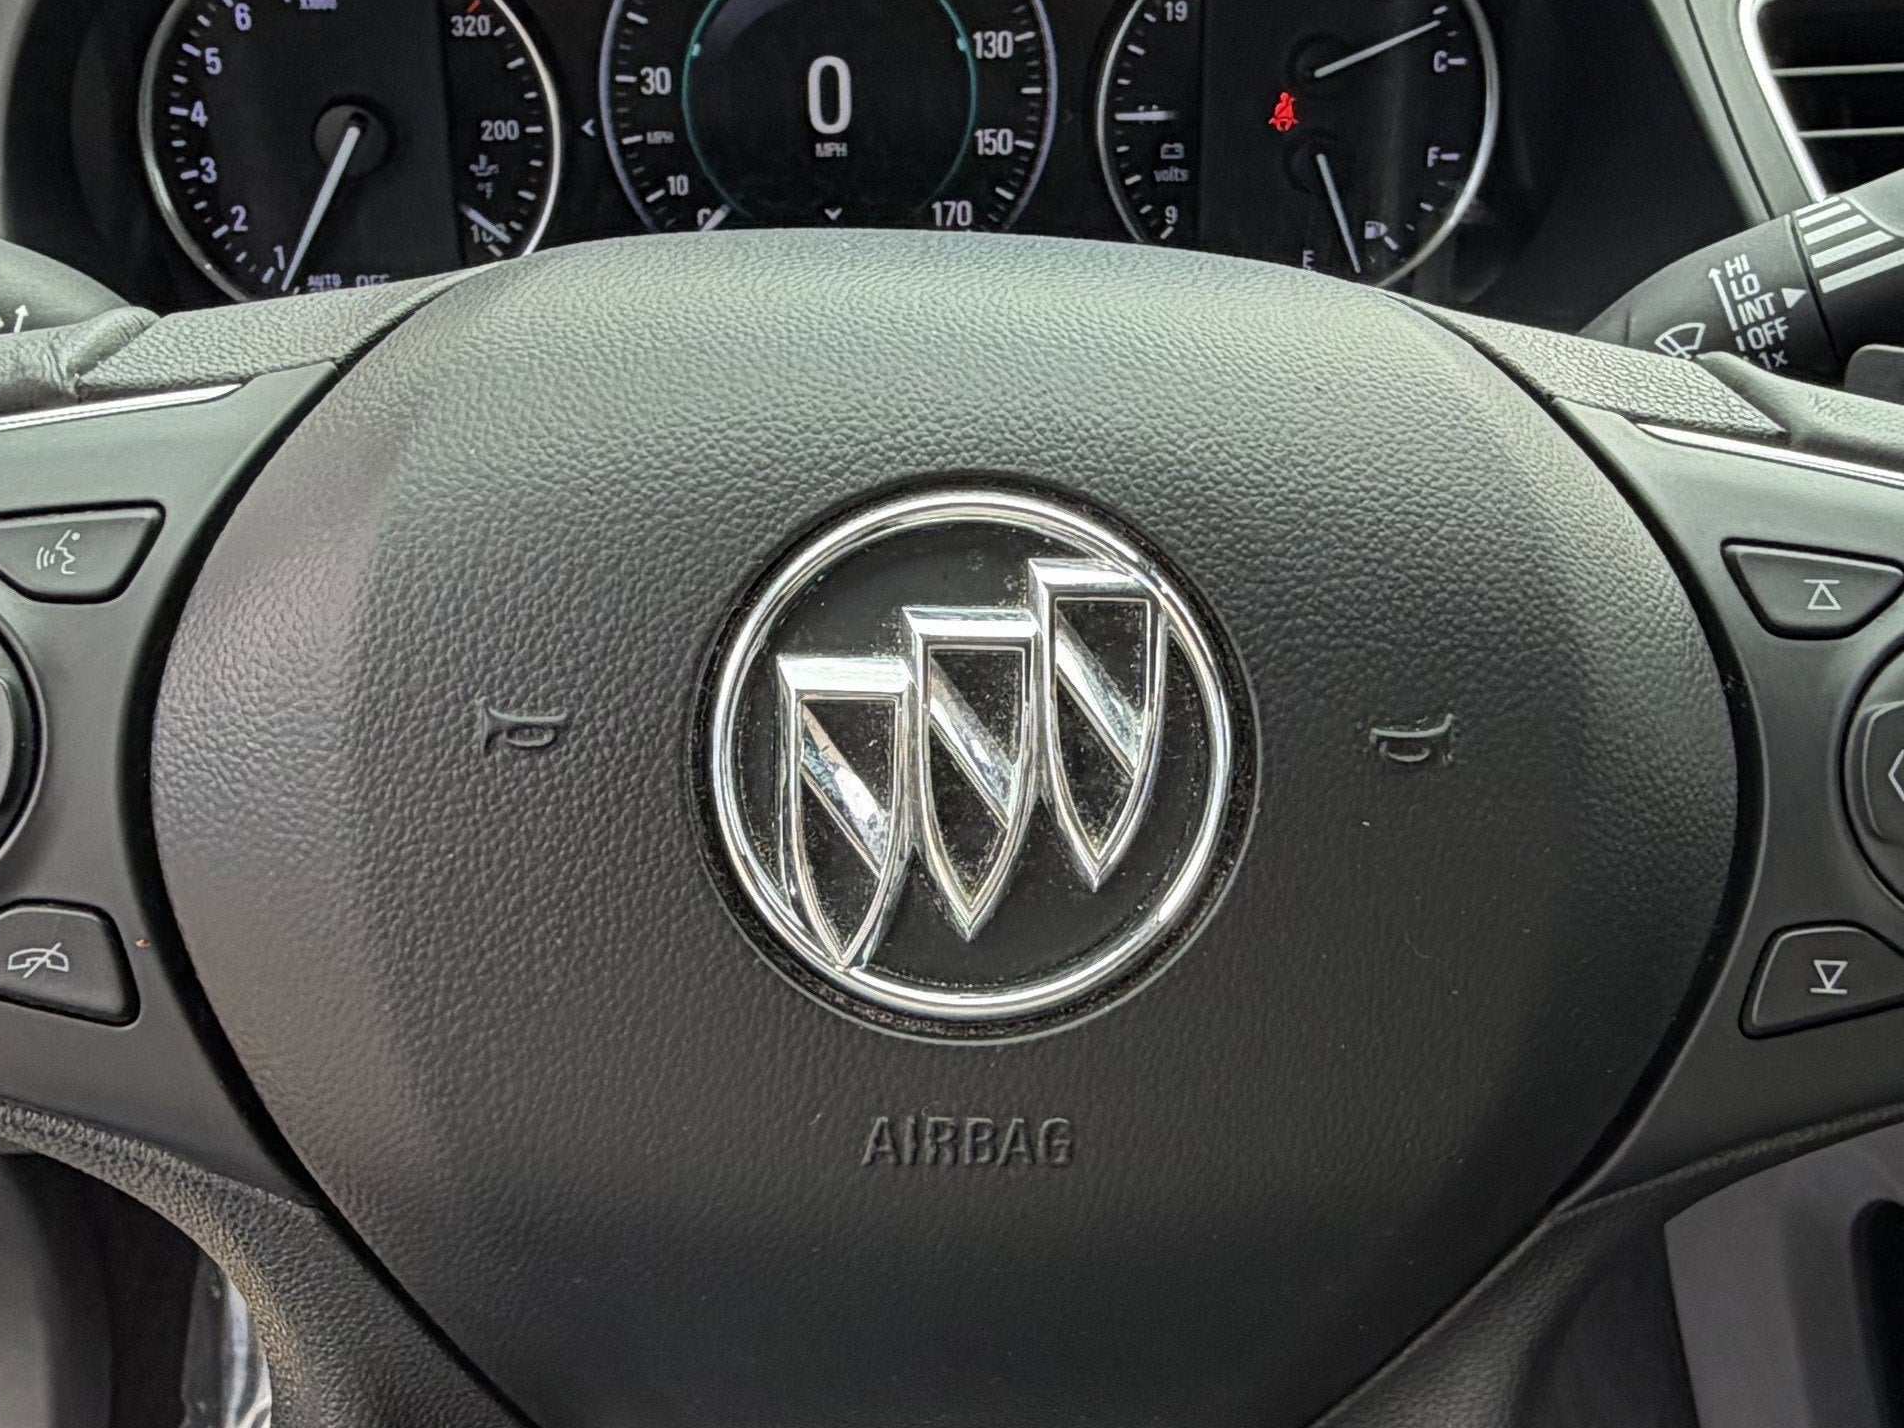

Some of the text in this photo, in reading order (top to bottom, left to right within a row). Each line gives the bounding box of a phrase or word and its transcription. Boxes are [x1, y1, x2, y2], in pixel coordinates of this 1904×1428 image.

[234, 4, 252, 31] 6
[1164, 0, 1188, 22] 19
[451, 15, 492, 37] 320
[973, 30, 1014, 59] 130
[205, 48, 222, 74] 5
[1433, 50, 1448, 72] C
[640, 67, 672, 95] 30
[806, 54, 853, 135] 0
[190, 101, 208, 128] 4
[480, 120, 520, 142] 200
[974, 128, 1014, 156] 150
[815, 142, 848, 158] MPH
[1427, 146, 1441, 168] F
[200, 156, 218, 184] 3
[667, 174, 690, 197] 10
[230, 205, 249, 232] 2
[932, 199, 973, 227] 170
[1164, 205, 1179, 225] 9
[273, 244, 285, 270] 1
[1302, 249, 1315, 270] E
[1724, 253, 1751, 278] HI
[1729, 273, 1761, 300] LO
[1737, 291, 1776, 325] INT
[1746, 316, 1789, 350] OFF
[861, 1116, 1073, 1167] AIRBAG
